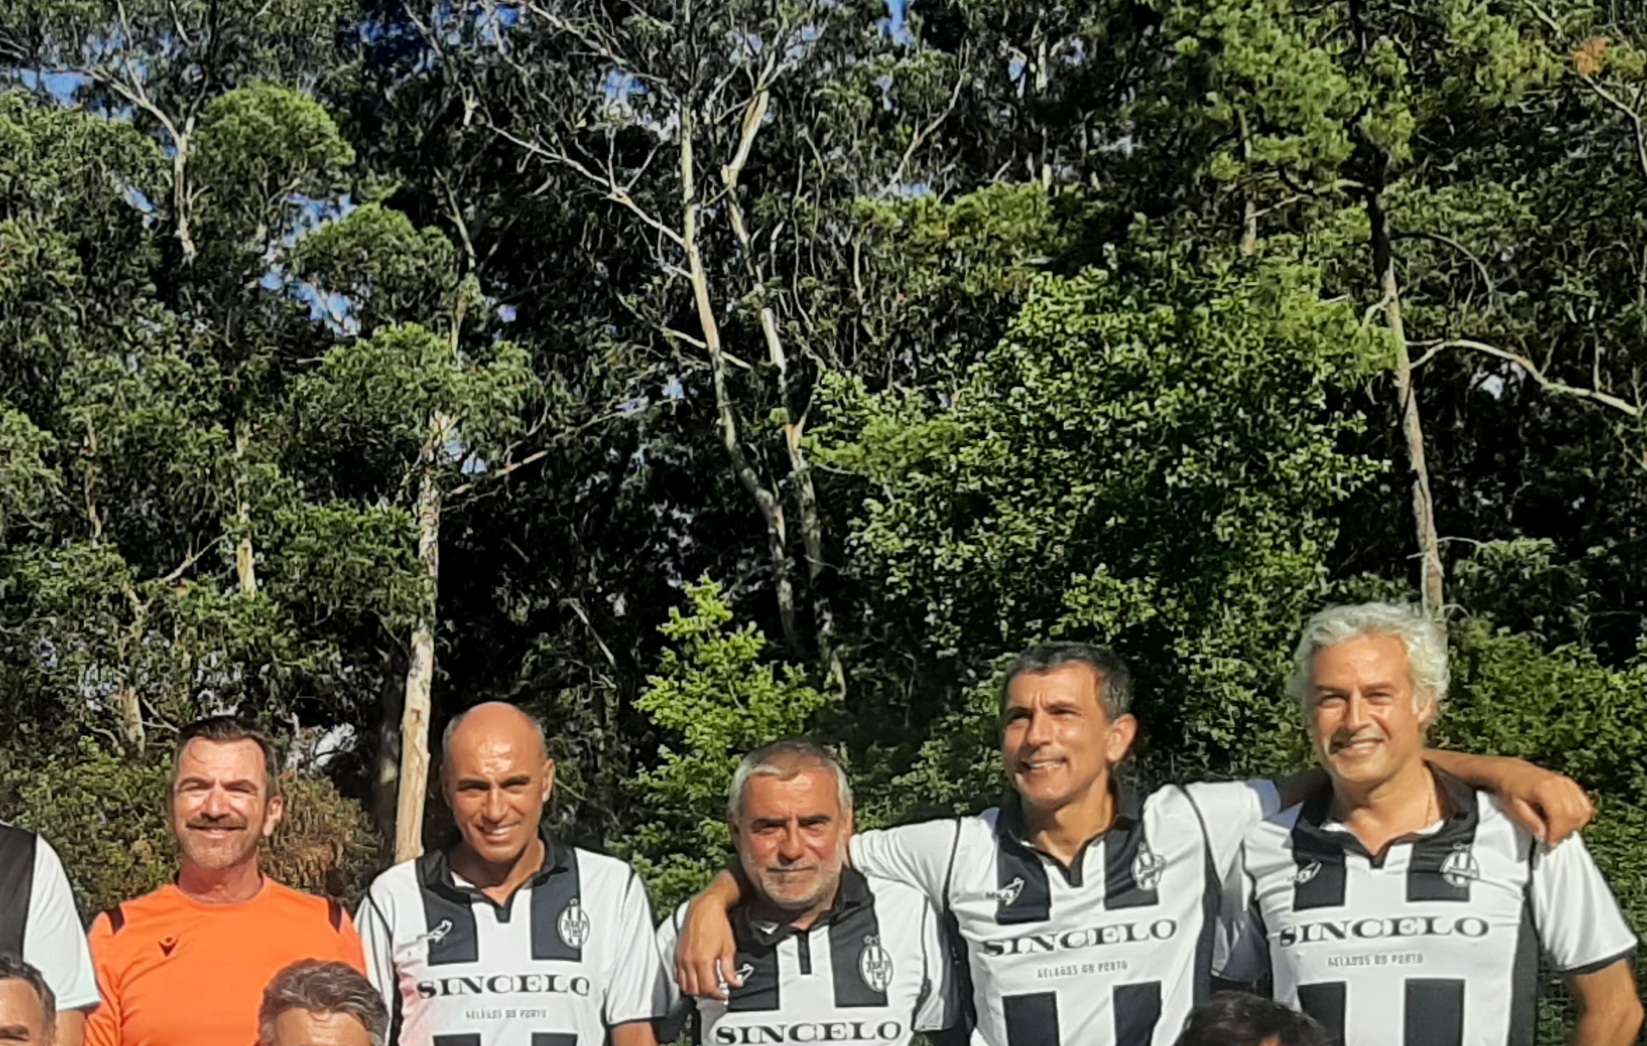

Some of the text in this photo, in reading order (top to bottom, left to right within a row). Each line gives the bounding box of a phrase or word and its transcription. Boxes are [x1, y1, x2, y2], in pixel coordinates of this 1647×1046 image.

[983, 919, 1177, 956] SINCELO
[1279, 916, 1489, 947] SINCELO
[416, 975, 590, 999] SINCELO
[715, 1020, 902, 1046] SINCELO
